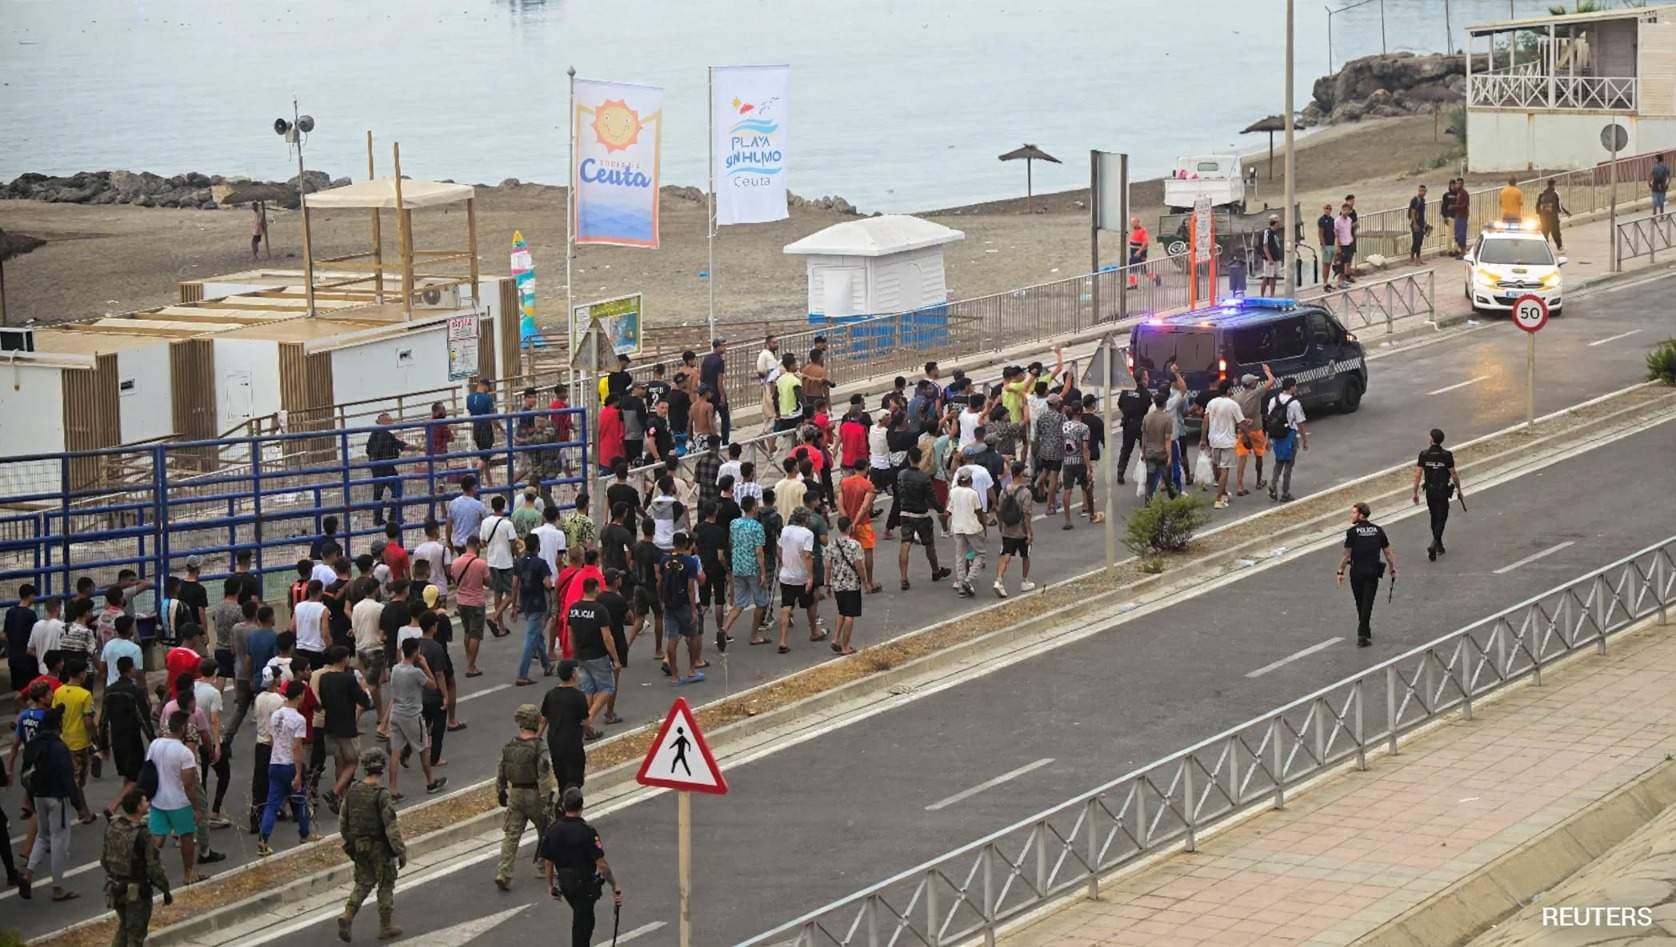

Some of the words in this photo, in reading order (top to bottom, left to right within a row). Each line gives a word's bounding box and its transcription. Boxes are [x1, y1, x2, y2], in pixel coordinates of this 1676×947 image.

[731, 136, 770, 151] PLAYA
[742, 150, 782, 167] HUMO
[580, 158, 652, 188] Ceuta
[734, 176, 771, 187] Ceuta
[1520, 307, 1540, 319] 50
